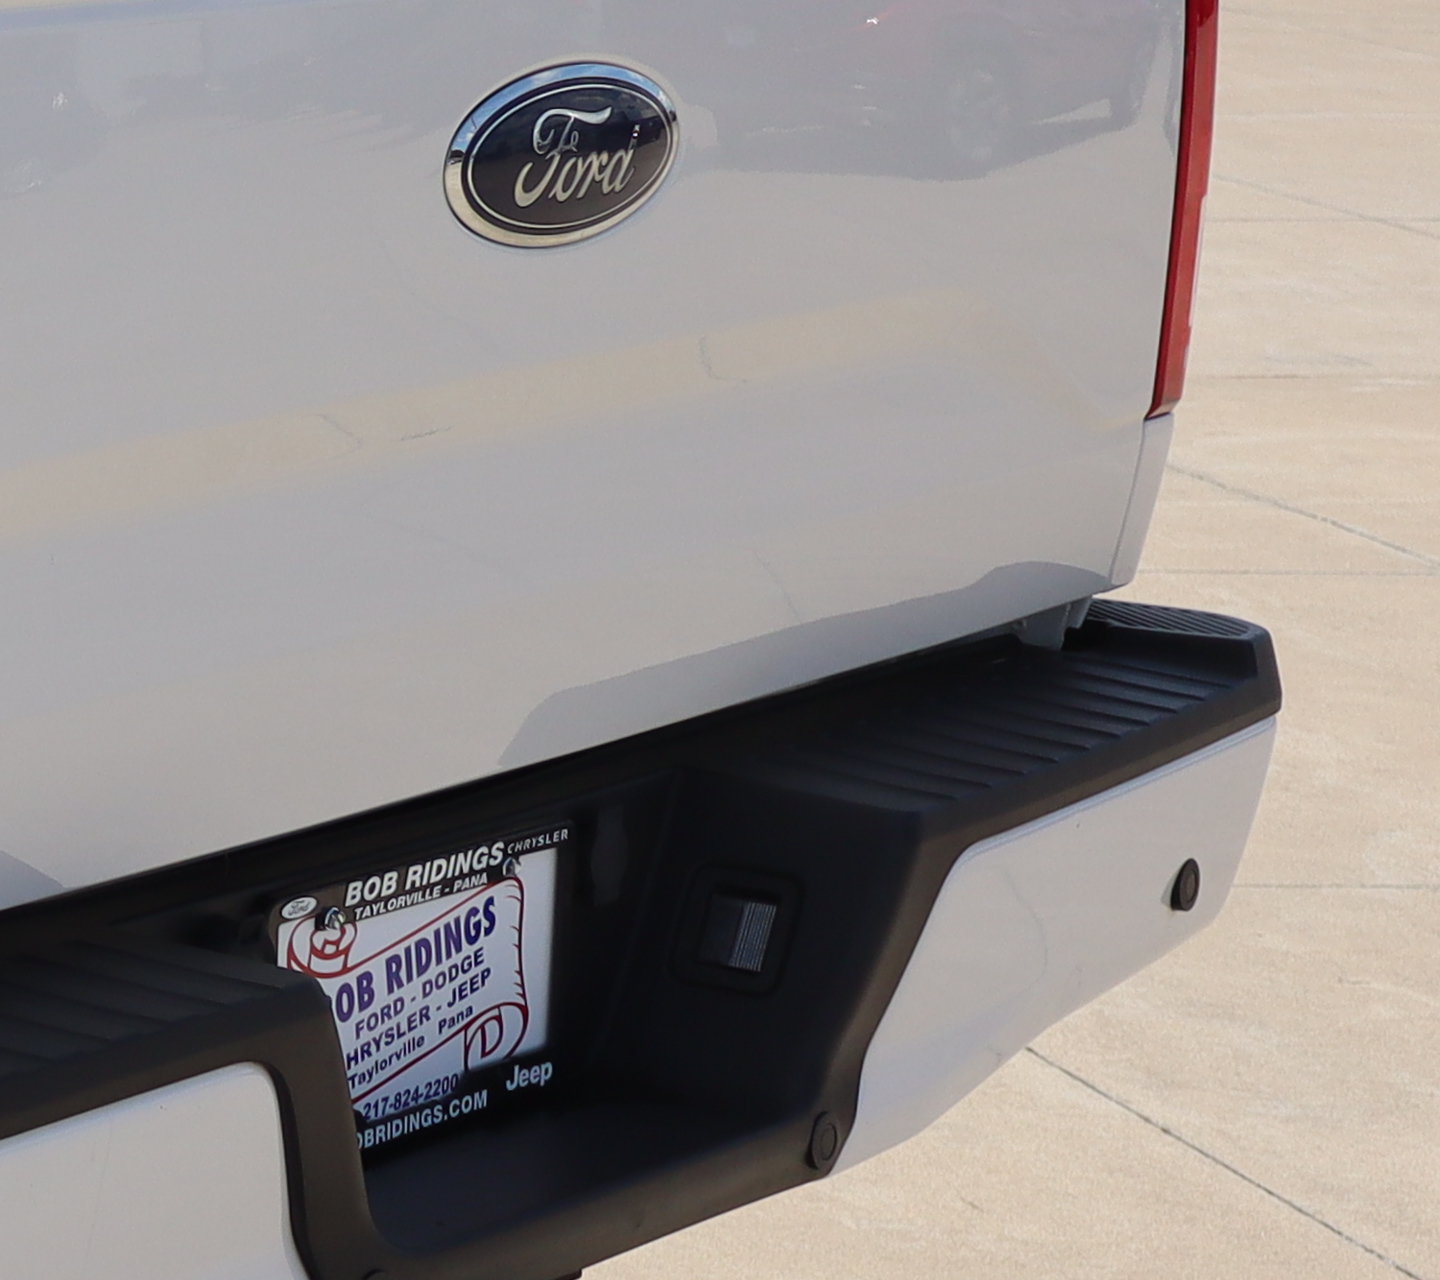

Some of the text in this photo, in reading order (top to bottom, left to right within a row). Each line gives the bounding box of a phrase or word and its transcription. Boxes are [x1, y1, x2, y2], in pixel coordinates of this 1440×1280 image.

[511, 106, 644, 209] Ford
[344, 841, 506, 908] BOB RIDINGS
[507, 828, 569, 854] CHRYSLER
[354, 886, 441, 920] TAYLORVILLE
[454, 871, 489, 894] PANA
[336, 896, 497, 1023] OB RIDINGS
[355, 997, 405, 1040] FORD
[422, 946, 485, 1000] DODGE
[346, 1009, 431, 1070] HRYSLER
[447, 967, 492, 1009] JEEP
[348, 1005, 474, 1090] Taylorville Pana
[363, 1073, 459, 1120] 217-824-2200
[505, 1061, 553, 1092] Jeep
[357, 1089, 489, 1149] BRIDINGS.COM
